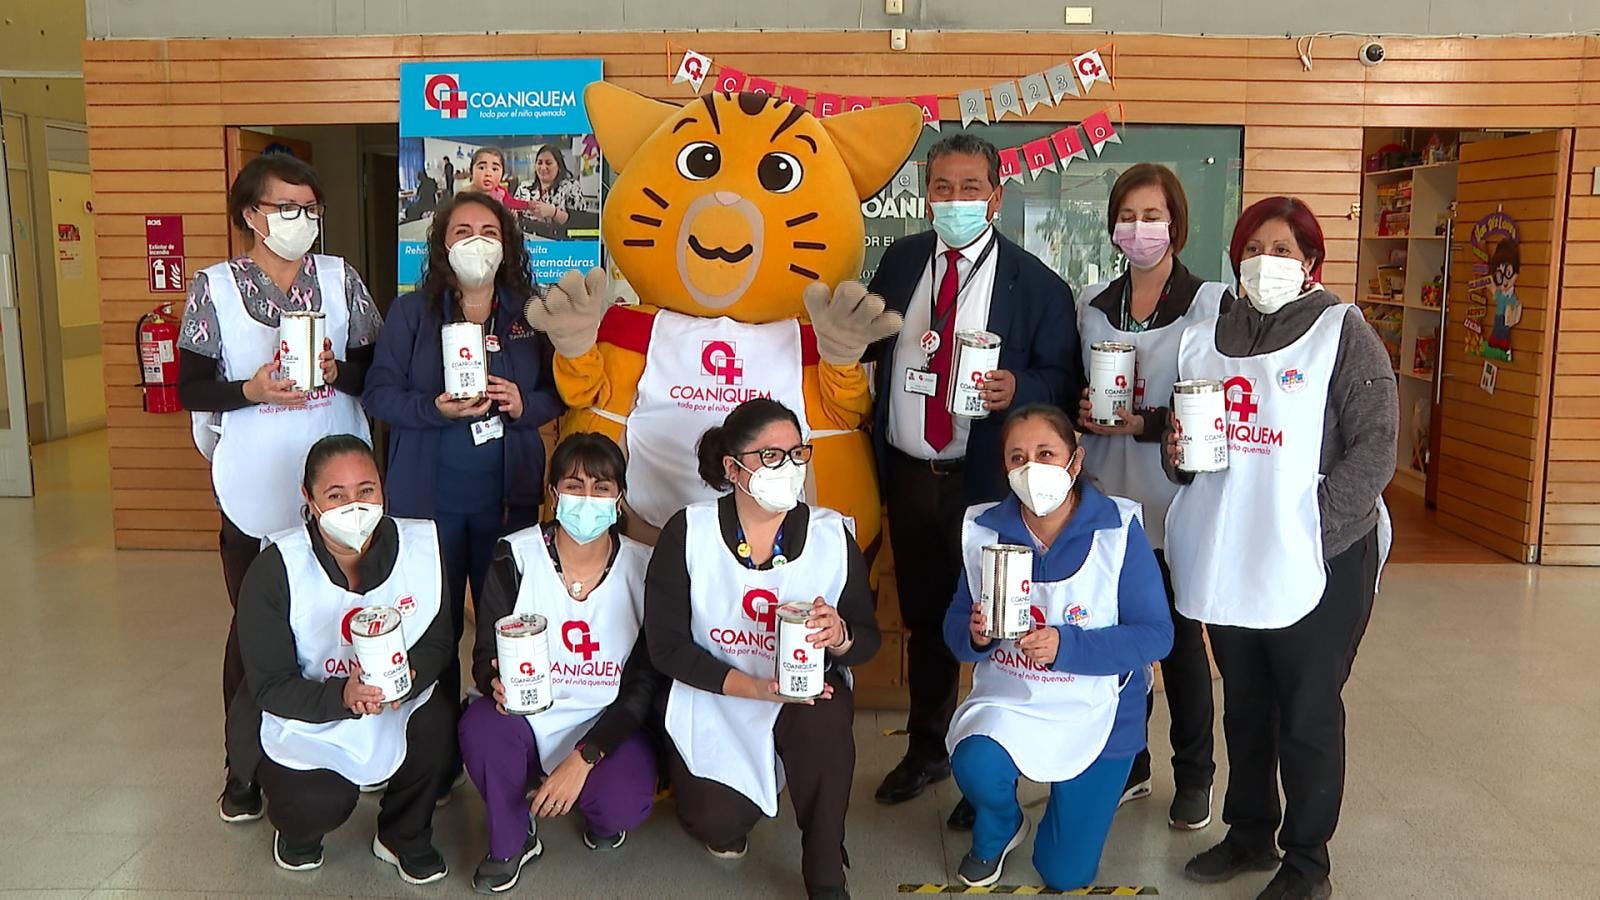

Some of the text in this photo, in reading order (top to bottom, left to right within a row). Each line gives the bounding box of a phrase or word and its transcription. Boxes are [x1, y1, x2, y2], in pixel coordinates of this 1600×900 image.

[470, 90, 576, 108] COANIQUEM
[967, 75, 1068, 113] 2023
[479, 109, 567, 120] todo por el niño quemado
[1001, 127, 1106, 175] unio
[861, 197, 926, 219] OANI
[532, 255, 594, 268] uemaduras
[694, 404, 706, 412] por
[707, 403, 715, 411] el
[737, 646, 749, 658] por
[552, 677, 564, 686] por
[565, 677, 572, 685] el
[573, 677, 587, 686] niño
[587, 677, 620, 688] quemado
[1018, 671, 1025, 680] el
[1025, 672, 1041, 682] niño
[1041, 672, 1075, 684] quemado
